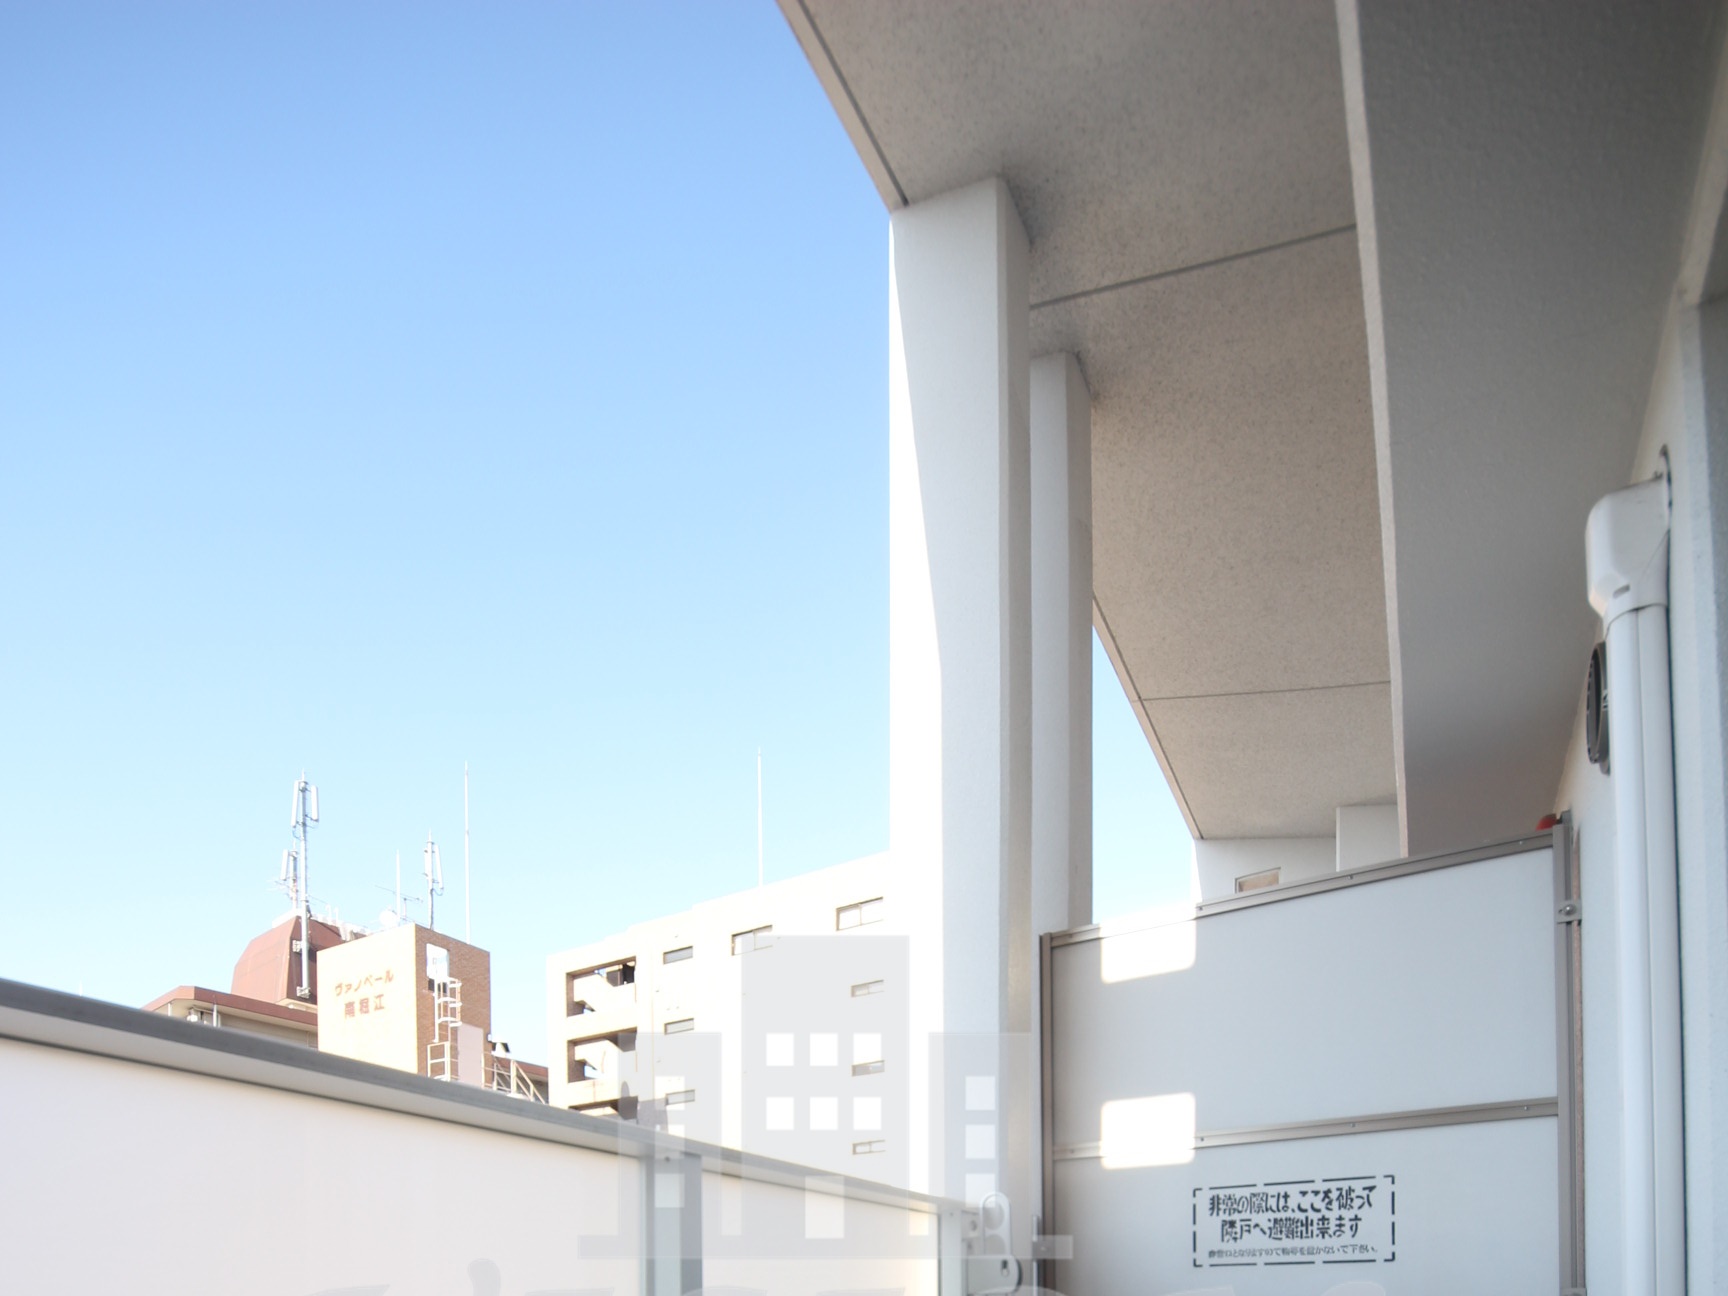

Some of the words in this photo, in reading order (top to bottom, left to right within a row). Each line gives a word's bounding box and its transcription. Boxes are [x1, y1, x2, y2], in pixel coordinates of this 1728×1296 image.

[1208, 1185, 1377, 1217] 非常の際には、ここを破って
[1221, 1214, 1363, 1243] 隣戸へ避難出来ます
